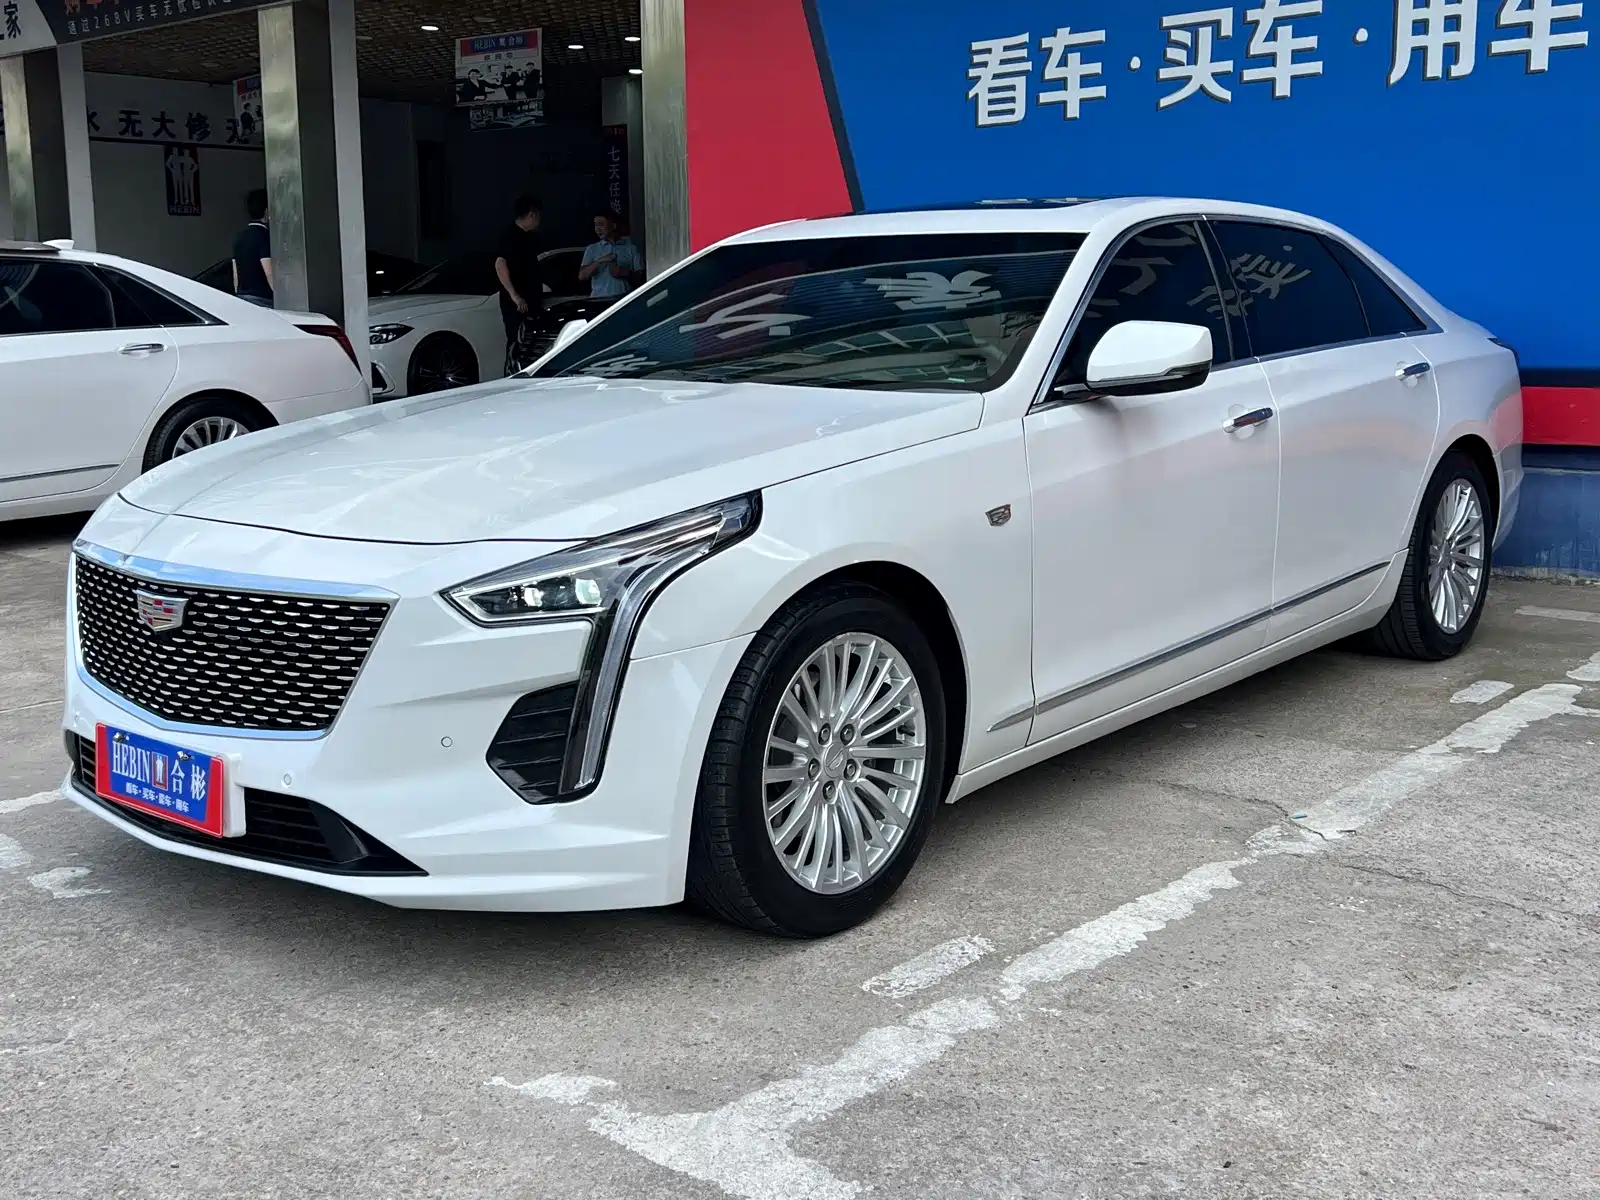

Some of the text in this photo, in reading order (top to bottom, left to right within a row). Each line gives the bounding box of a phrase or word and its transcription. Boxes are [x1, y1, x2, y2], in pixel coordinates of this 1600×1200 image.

[0, 1, 21, 39] 家
[112, 740, 207, 801] HEBIN 合彬
